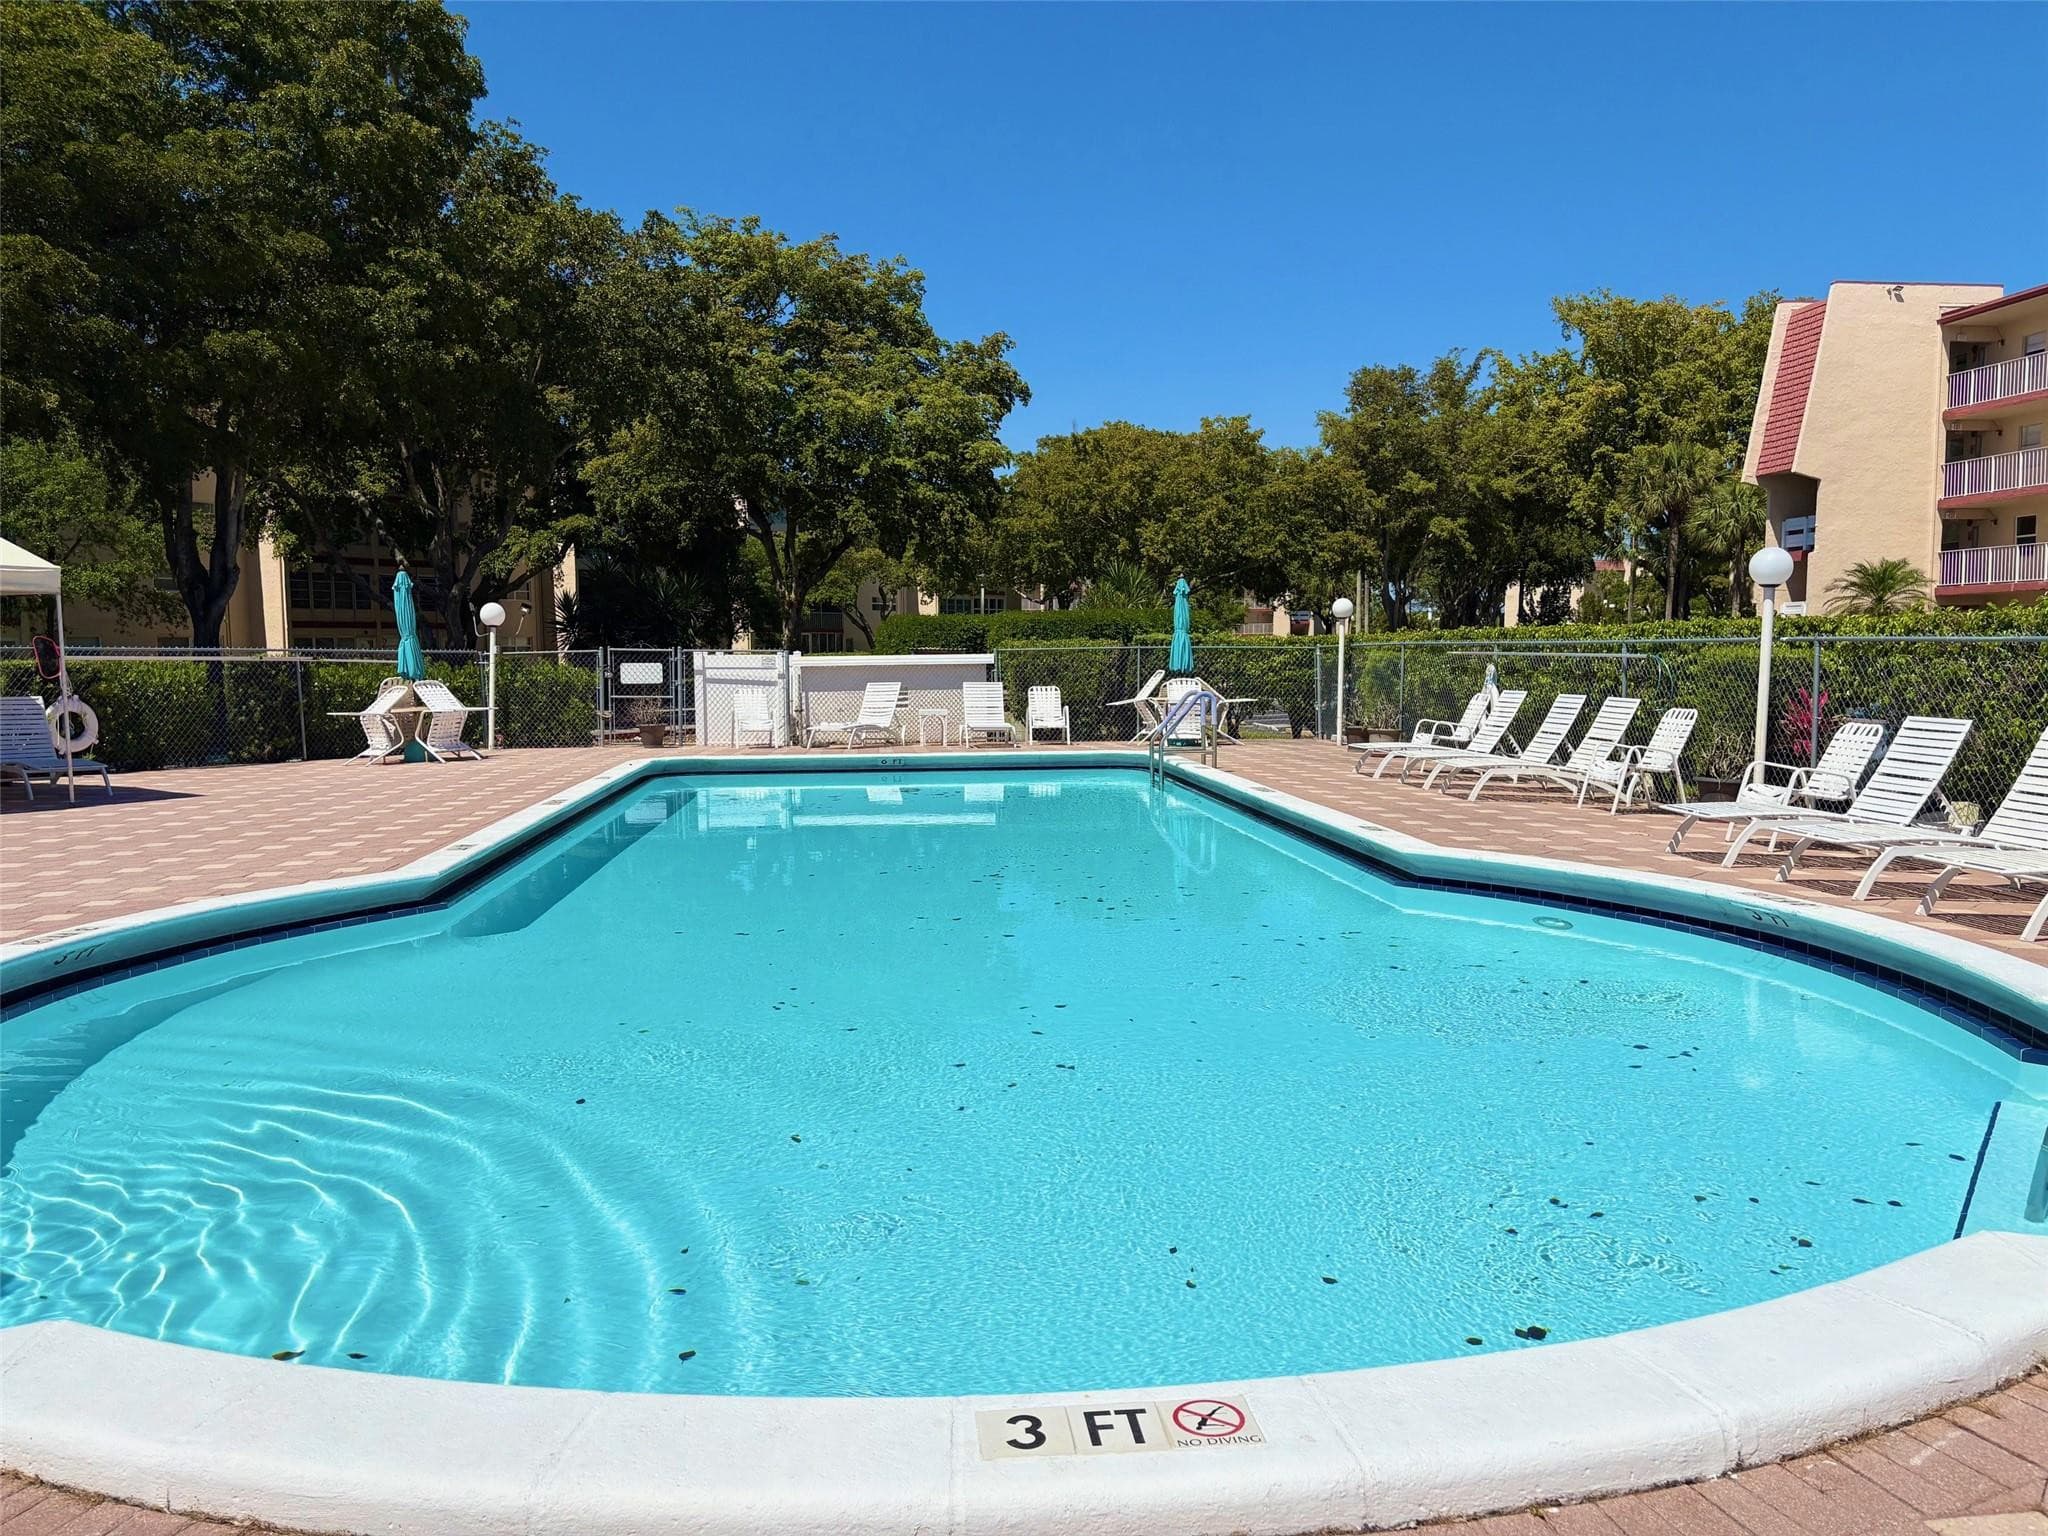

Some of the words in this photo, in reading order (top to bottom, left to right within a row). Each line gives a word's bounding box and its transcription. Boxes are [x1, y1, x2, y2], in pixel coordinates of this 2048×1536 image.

[1006, 1414, 1047, 1450] 3
[1083, 1408, 1147, 1447] FT
[1177, 1438, 1202, 1448] NO
[1208, 1434, 1262, 1446] DIVING
